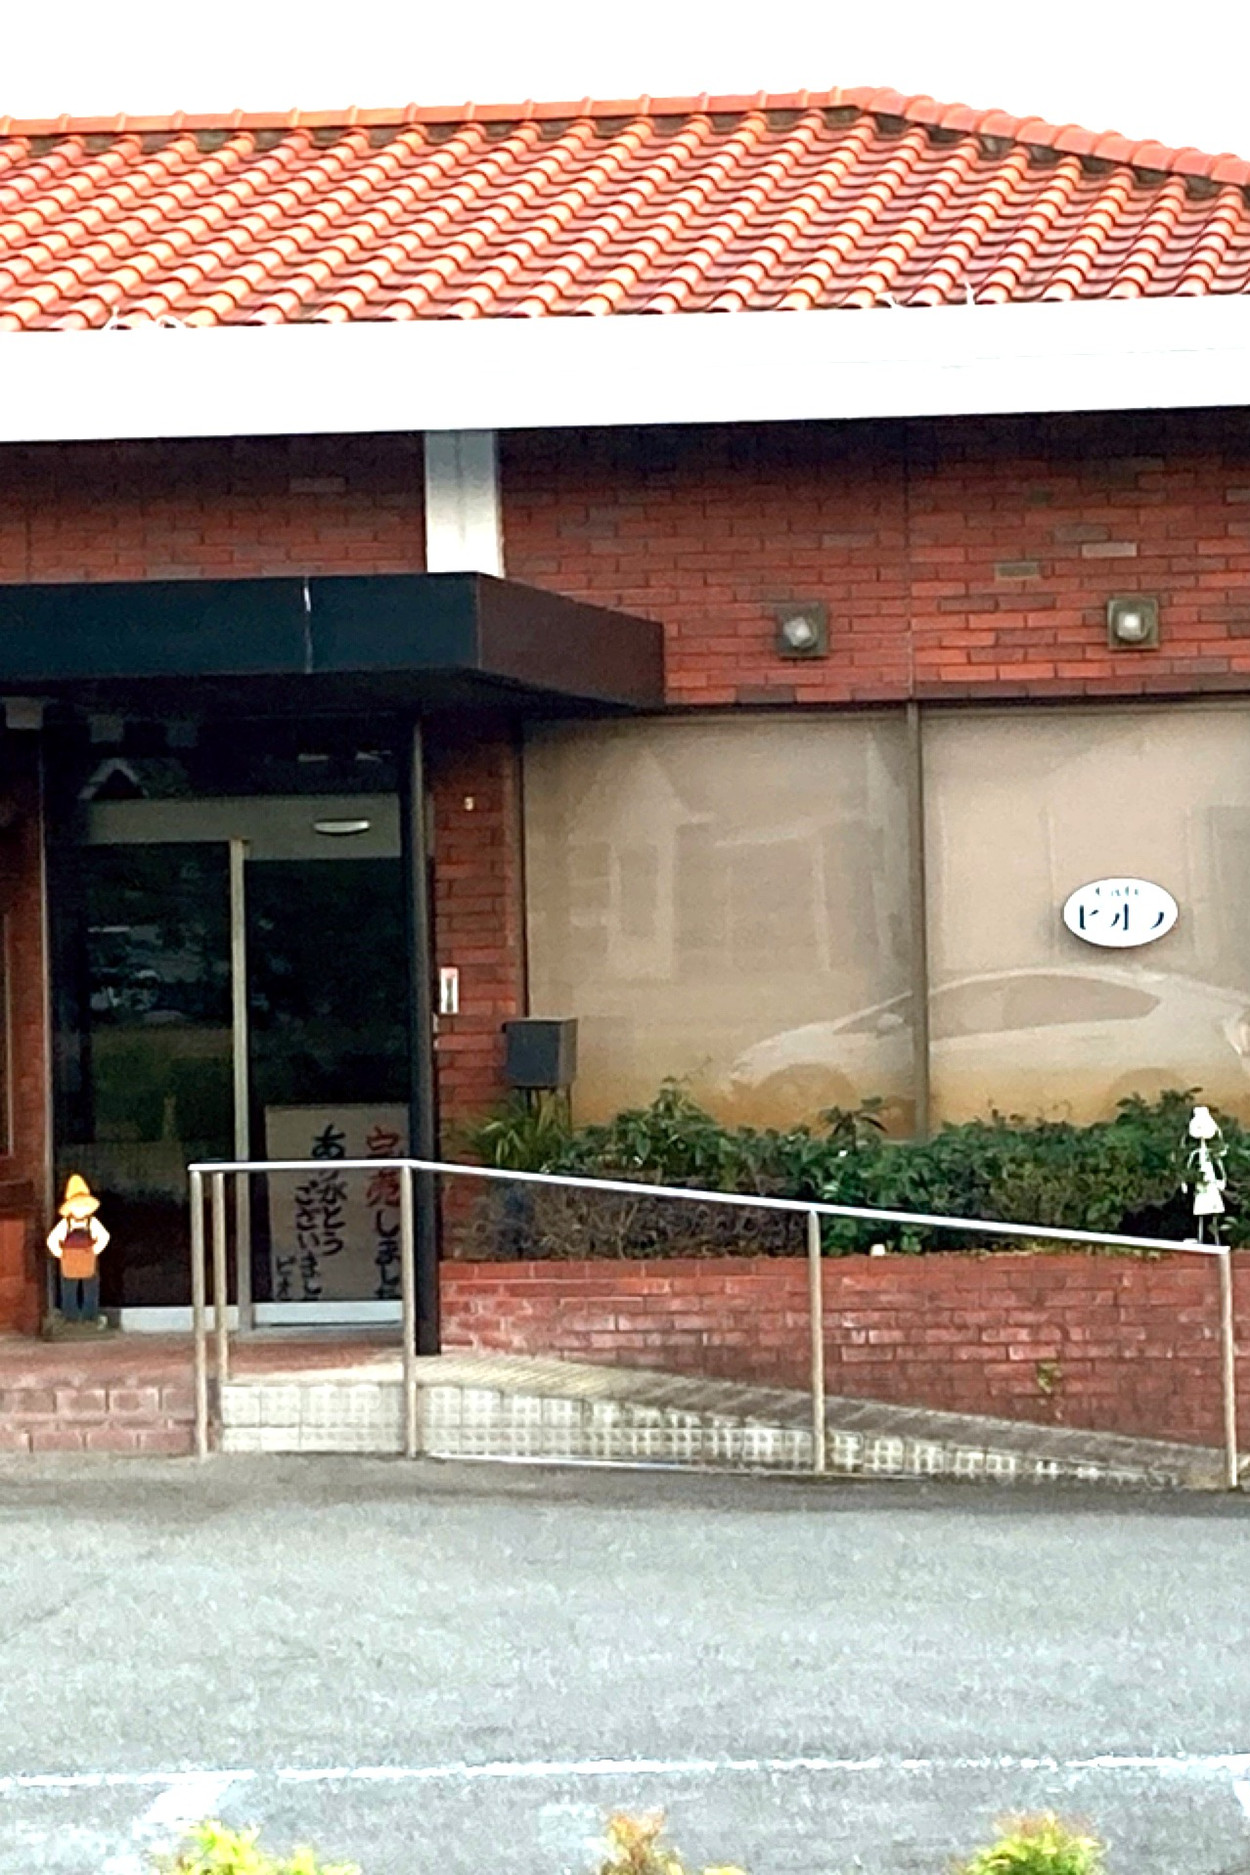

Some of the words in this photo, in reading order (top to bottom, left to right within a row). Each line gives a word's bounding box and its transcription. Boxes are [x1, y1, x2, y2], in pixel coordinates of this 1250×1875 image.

[295, 1179, 322, 1300] ございまし
